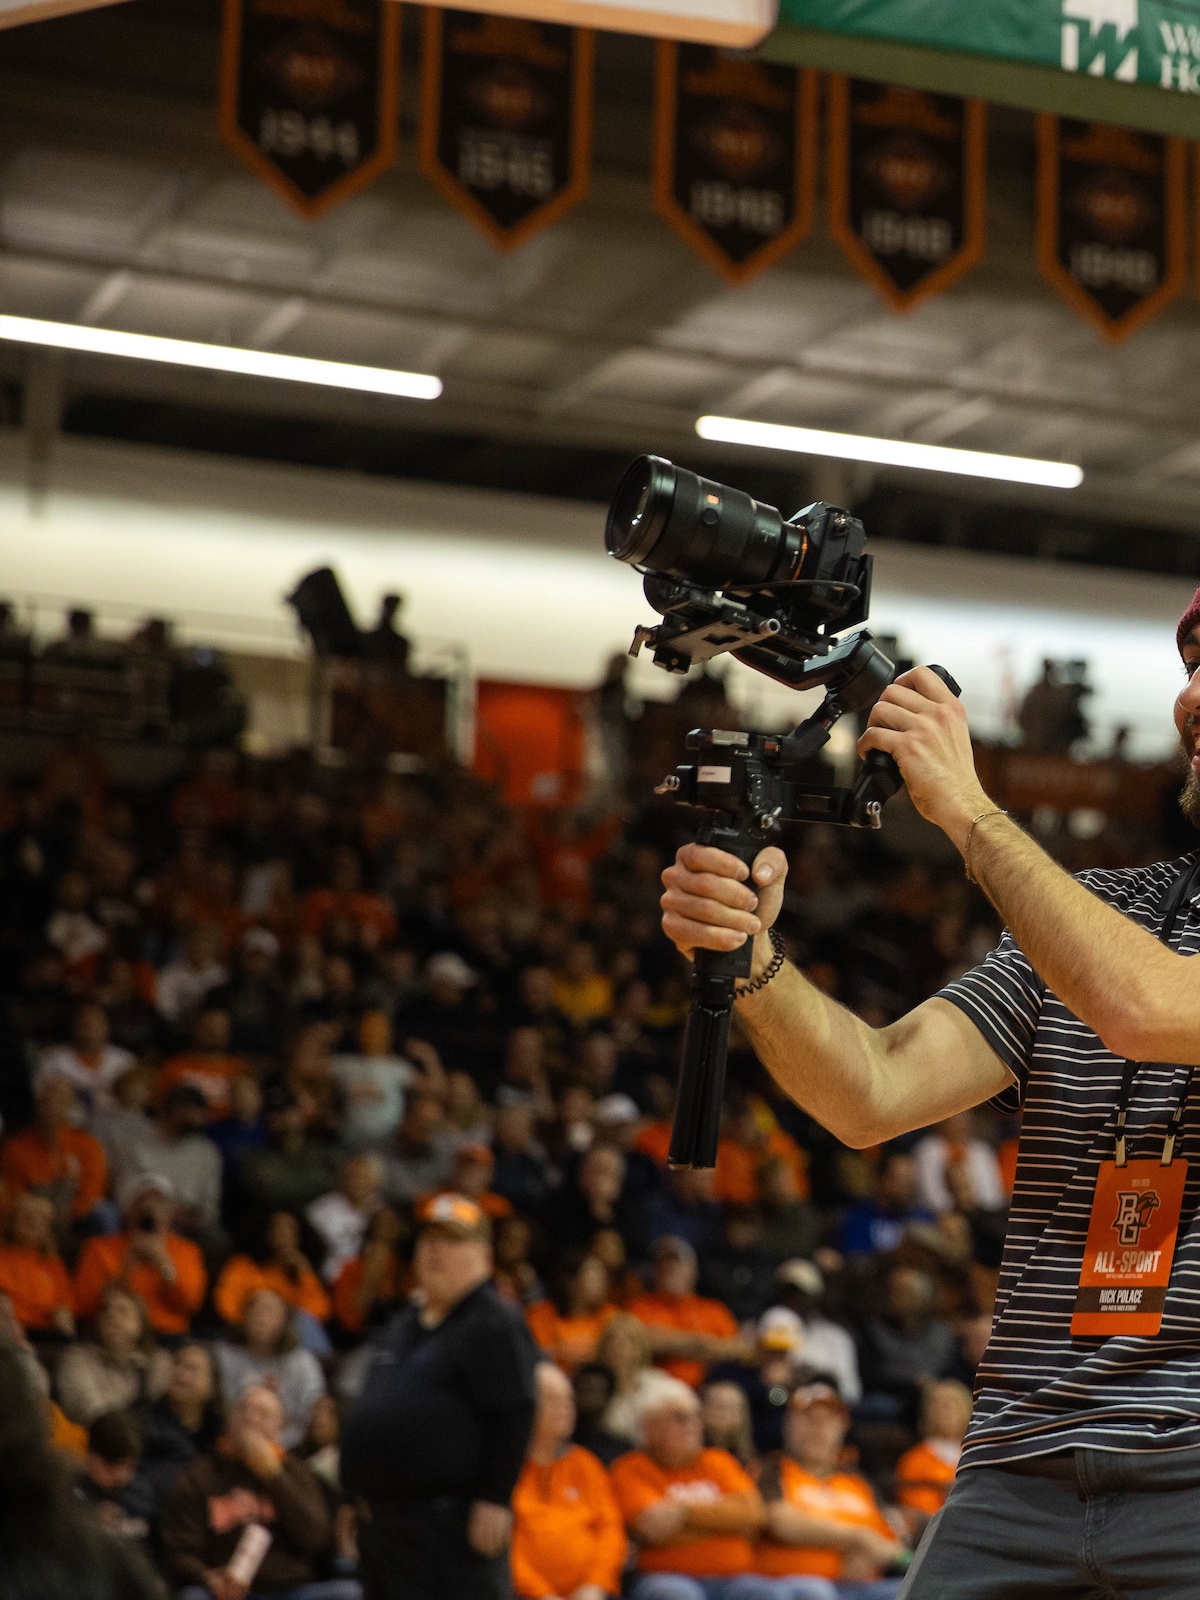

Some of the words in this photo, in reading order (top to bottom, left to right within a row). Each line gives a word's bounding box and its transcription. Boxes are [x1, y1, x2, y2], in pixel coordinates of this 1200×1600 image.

[260, 110, 358, 163] 1944
[1093, 1250, 1161, 1273] ALL-SPORT
[1099, 1289, 1117, 1303] NICK
[1116, 1289, 1143, 1303] POLACE
